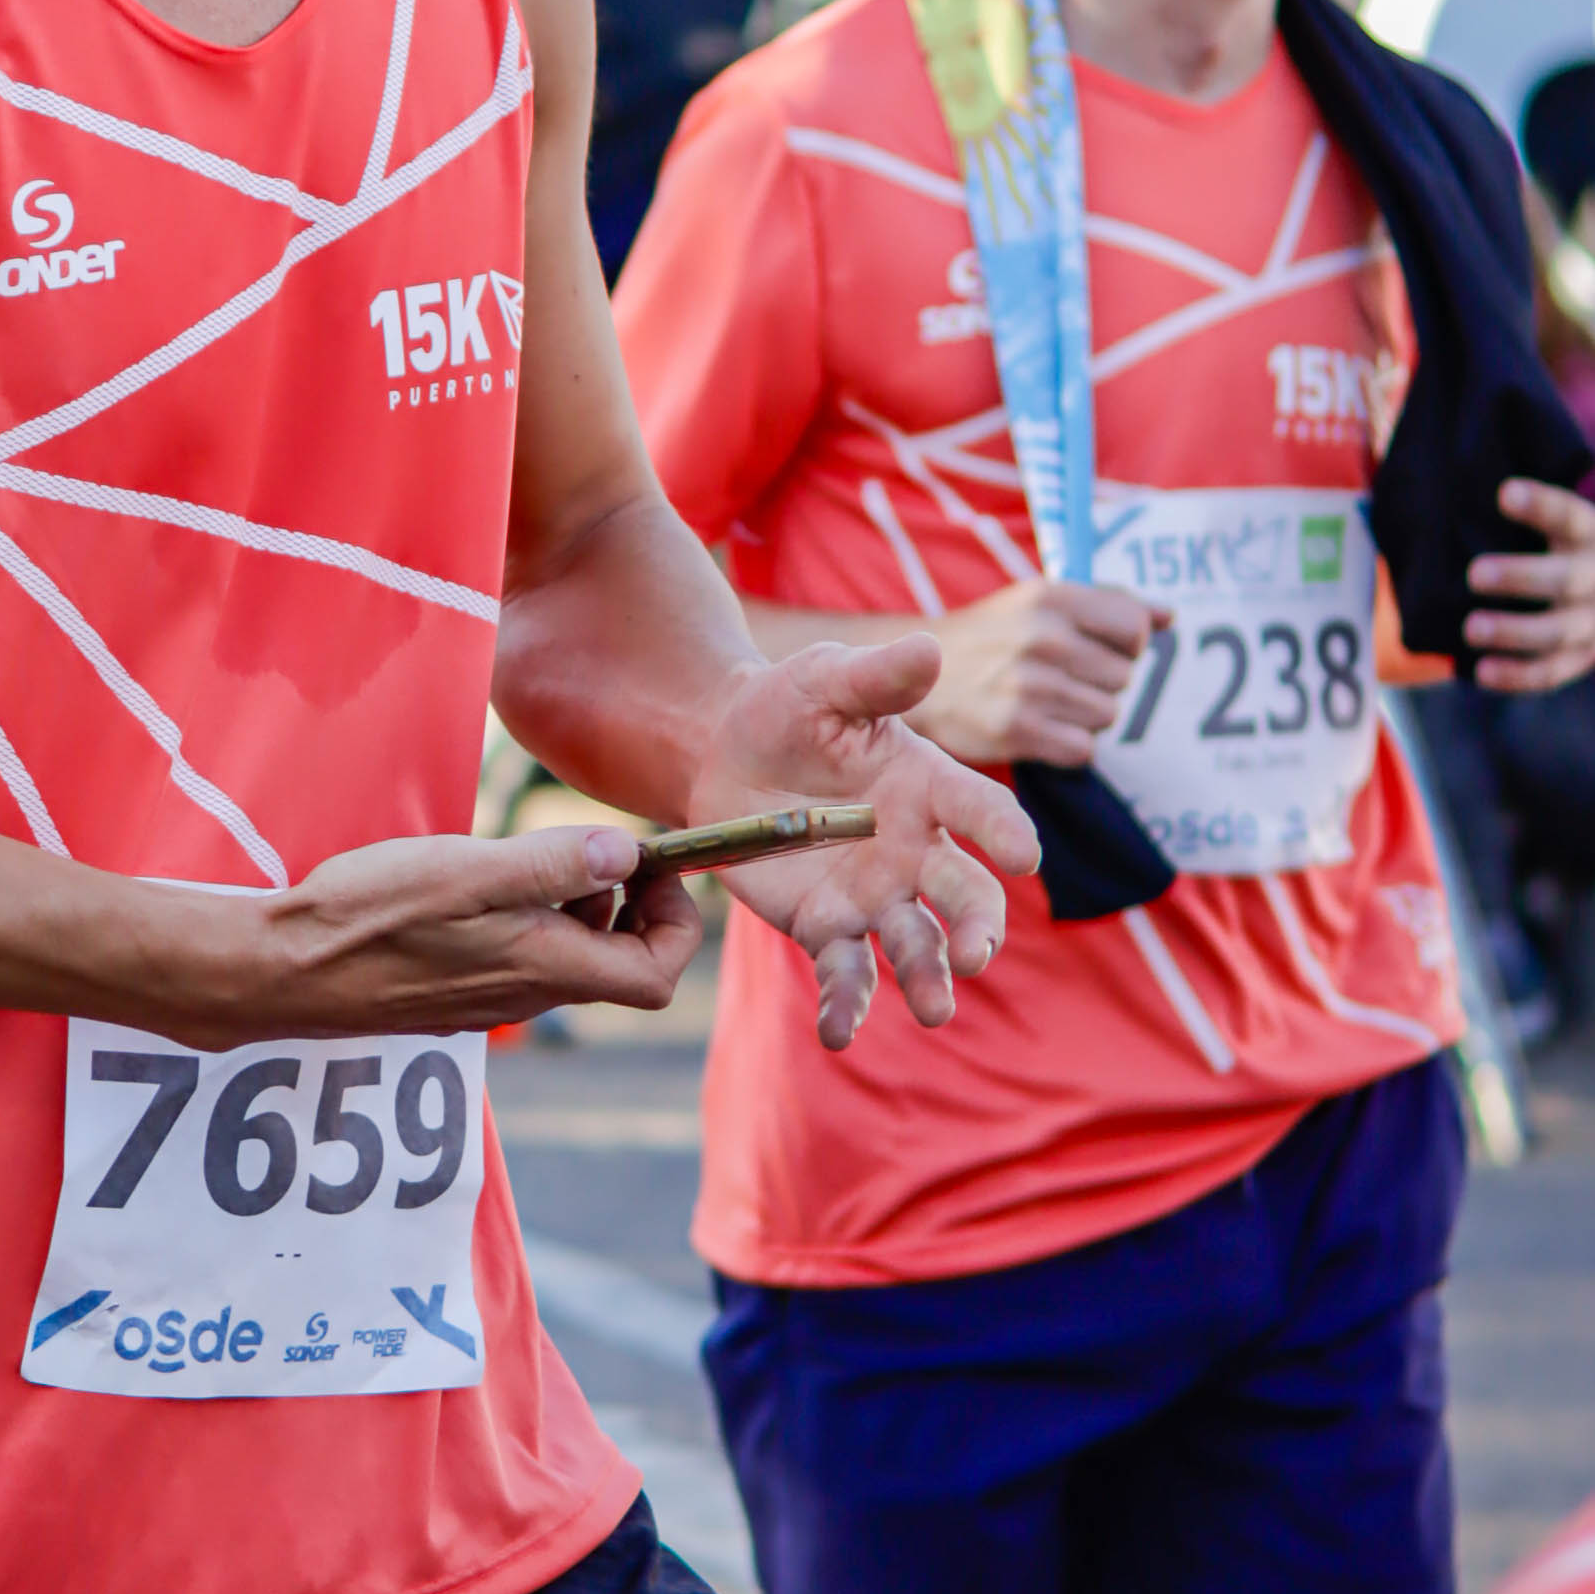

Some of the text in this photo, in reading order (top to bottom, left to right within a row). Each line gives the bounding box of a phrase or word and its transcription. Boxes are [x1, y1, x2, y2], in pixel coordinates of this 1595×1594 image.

[369, 273, 492, 379] 15K
[388, 373, 493, 411] PUERTO
[1124, 535, 1215, 587] 15K
[1117, 616, 1366, 745] 7238
[86, 1049, 468, 1217] 7659
[113, 1305, 264, 1365] osde
[352, 1327, 407, 1344] POWER
